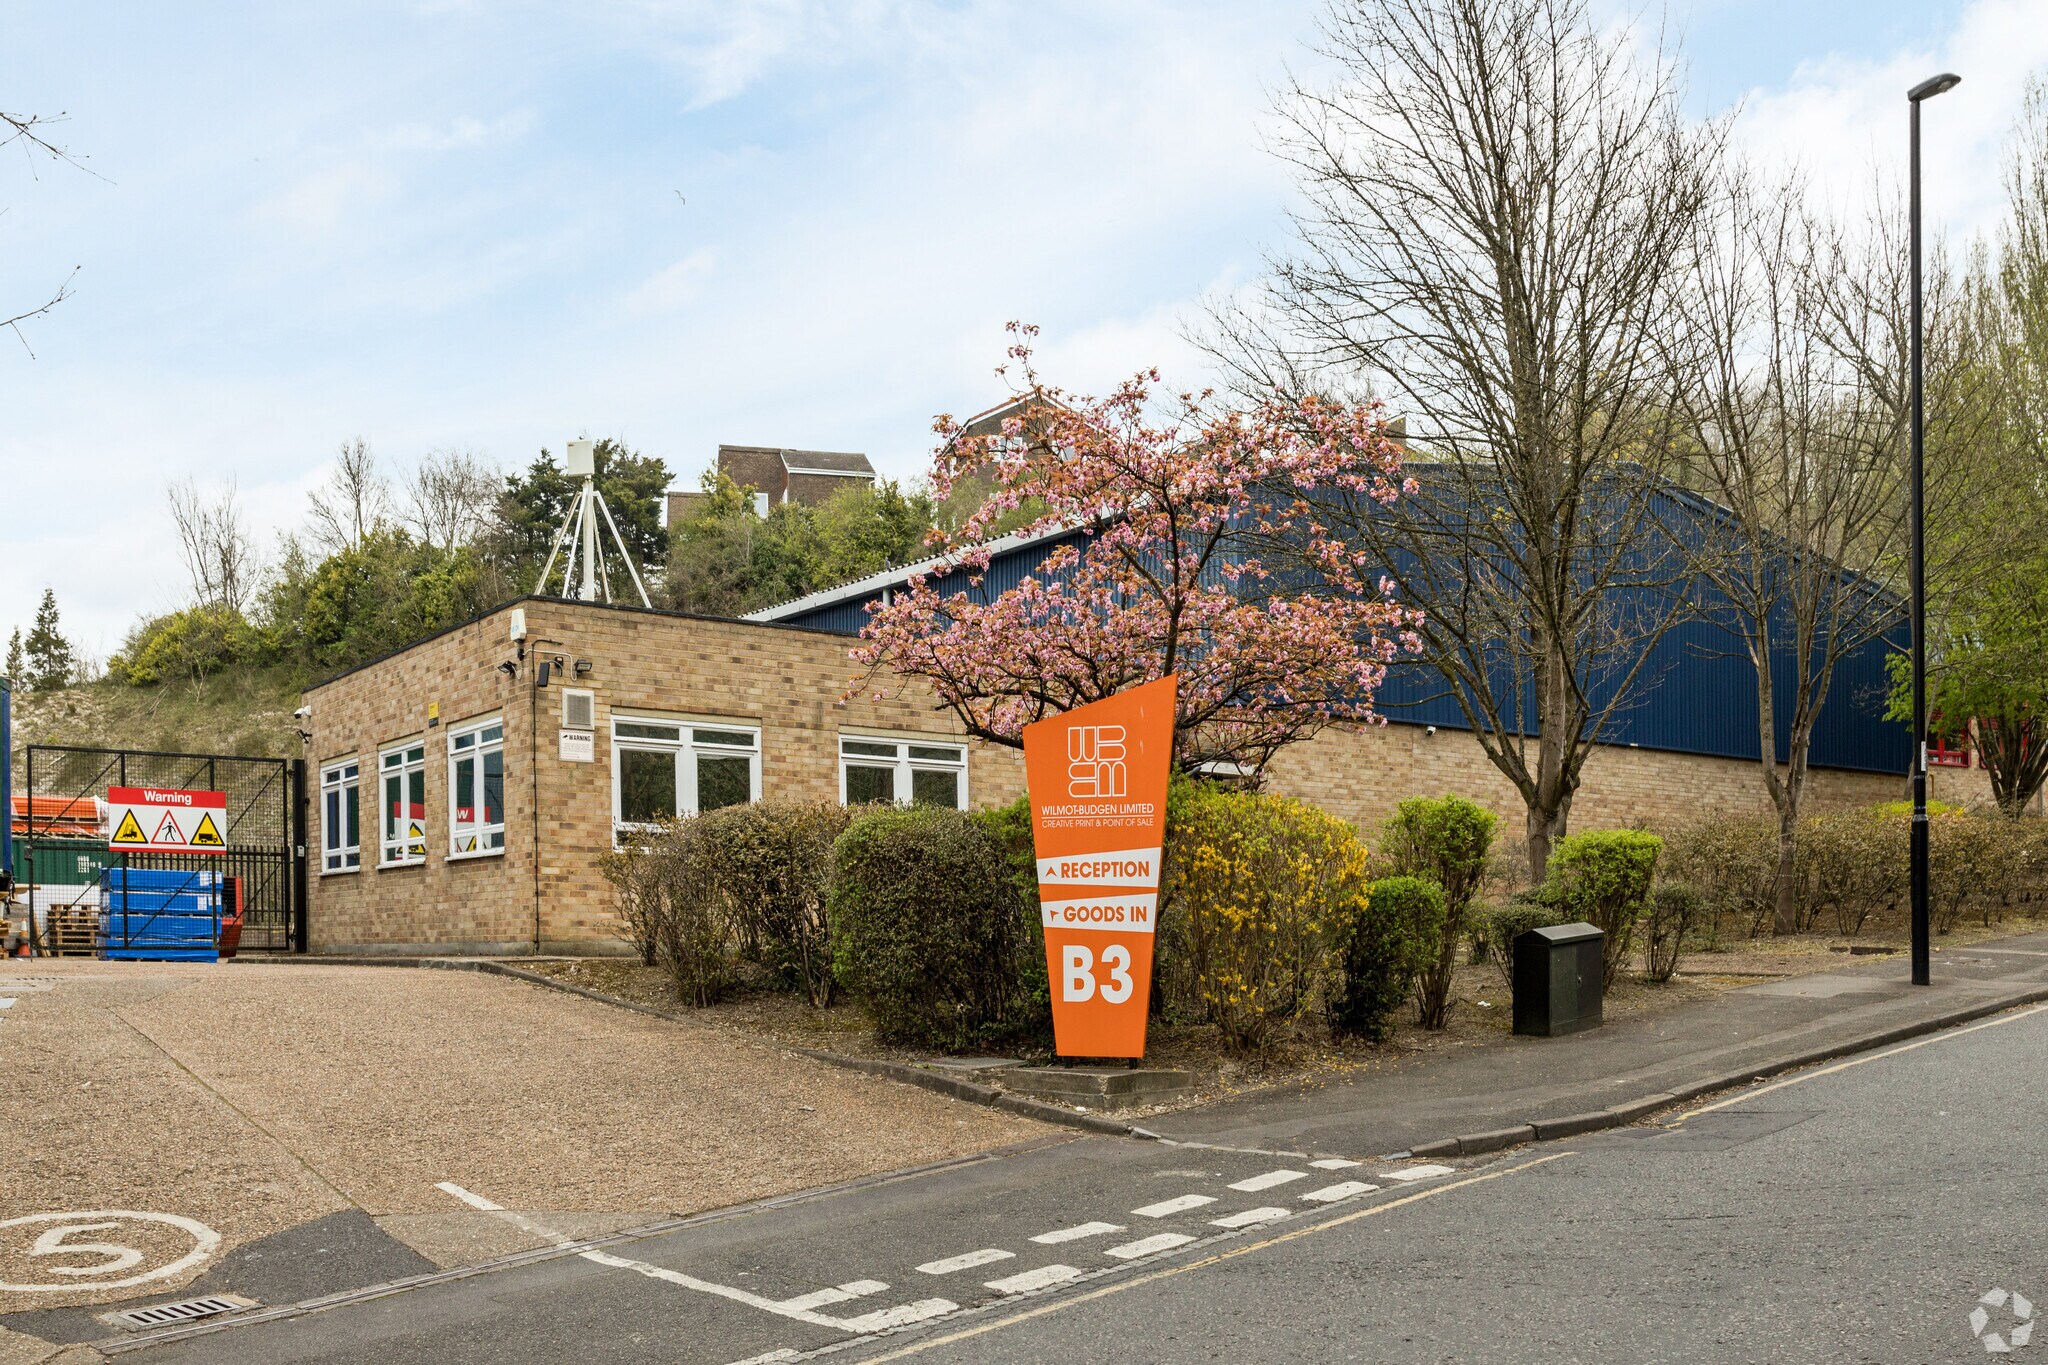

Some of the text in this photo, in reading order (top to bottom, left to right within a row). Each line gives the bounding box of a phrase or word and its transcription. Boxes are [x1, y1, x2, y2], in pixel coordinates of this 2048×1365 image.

[144, 790, 192, 805] Warning
[1041, 803, 1154, 815] WILMOT-BUDGEN LIMITED
[1041, 818, 1154, 828] CREATIVE PRINT & POINT OF SALE
[1061, 861, 1149, 878] RECEPTION
[1063, 906, 1147, 922] GOODS IN
[1062, 944, 1134, 1004] B3
[30, 1221, 144, 1276] 5
